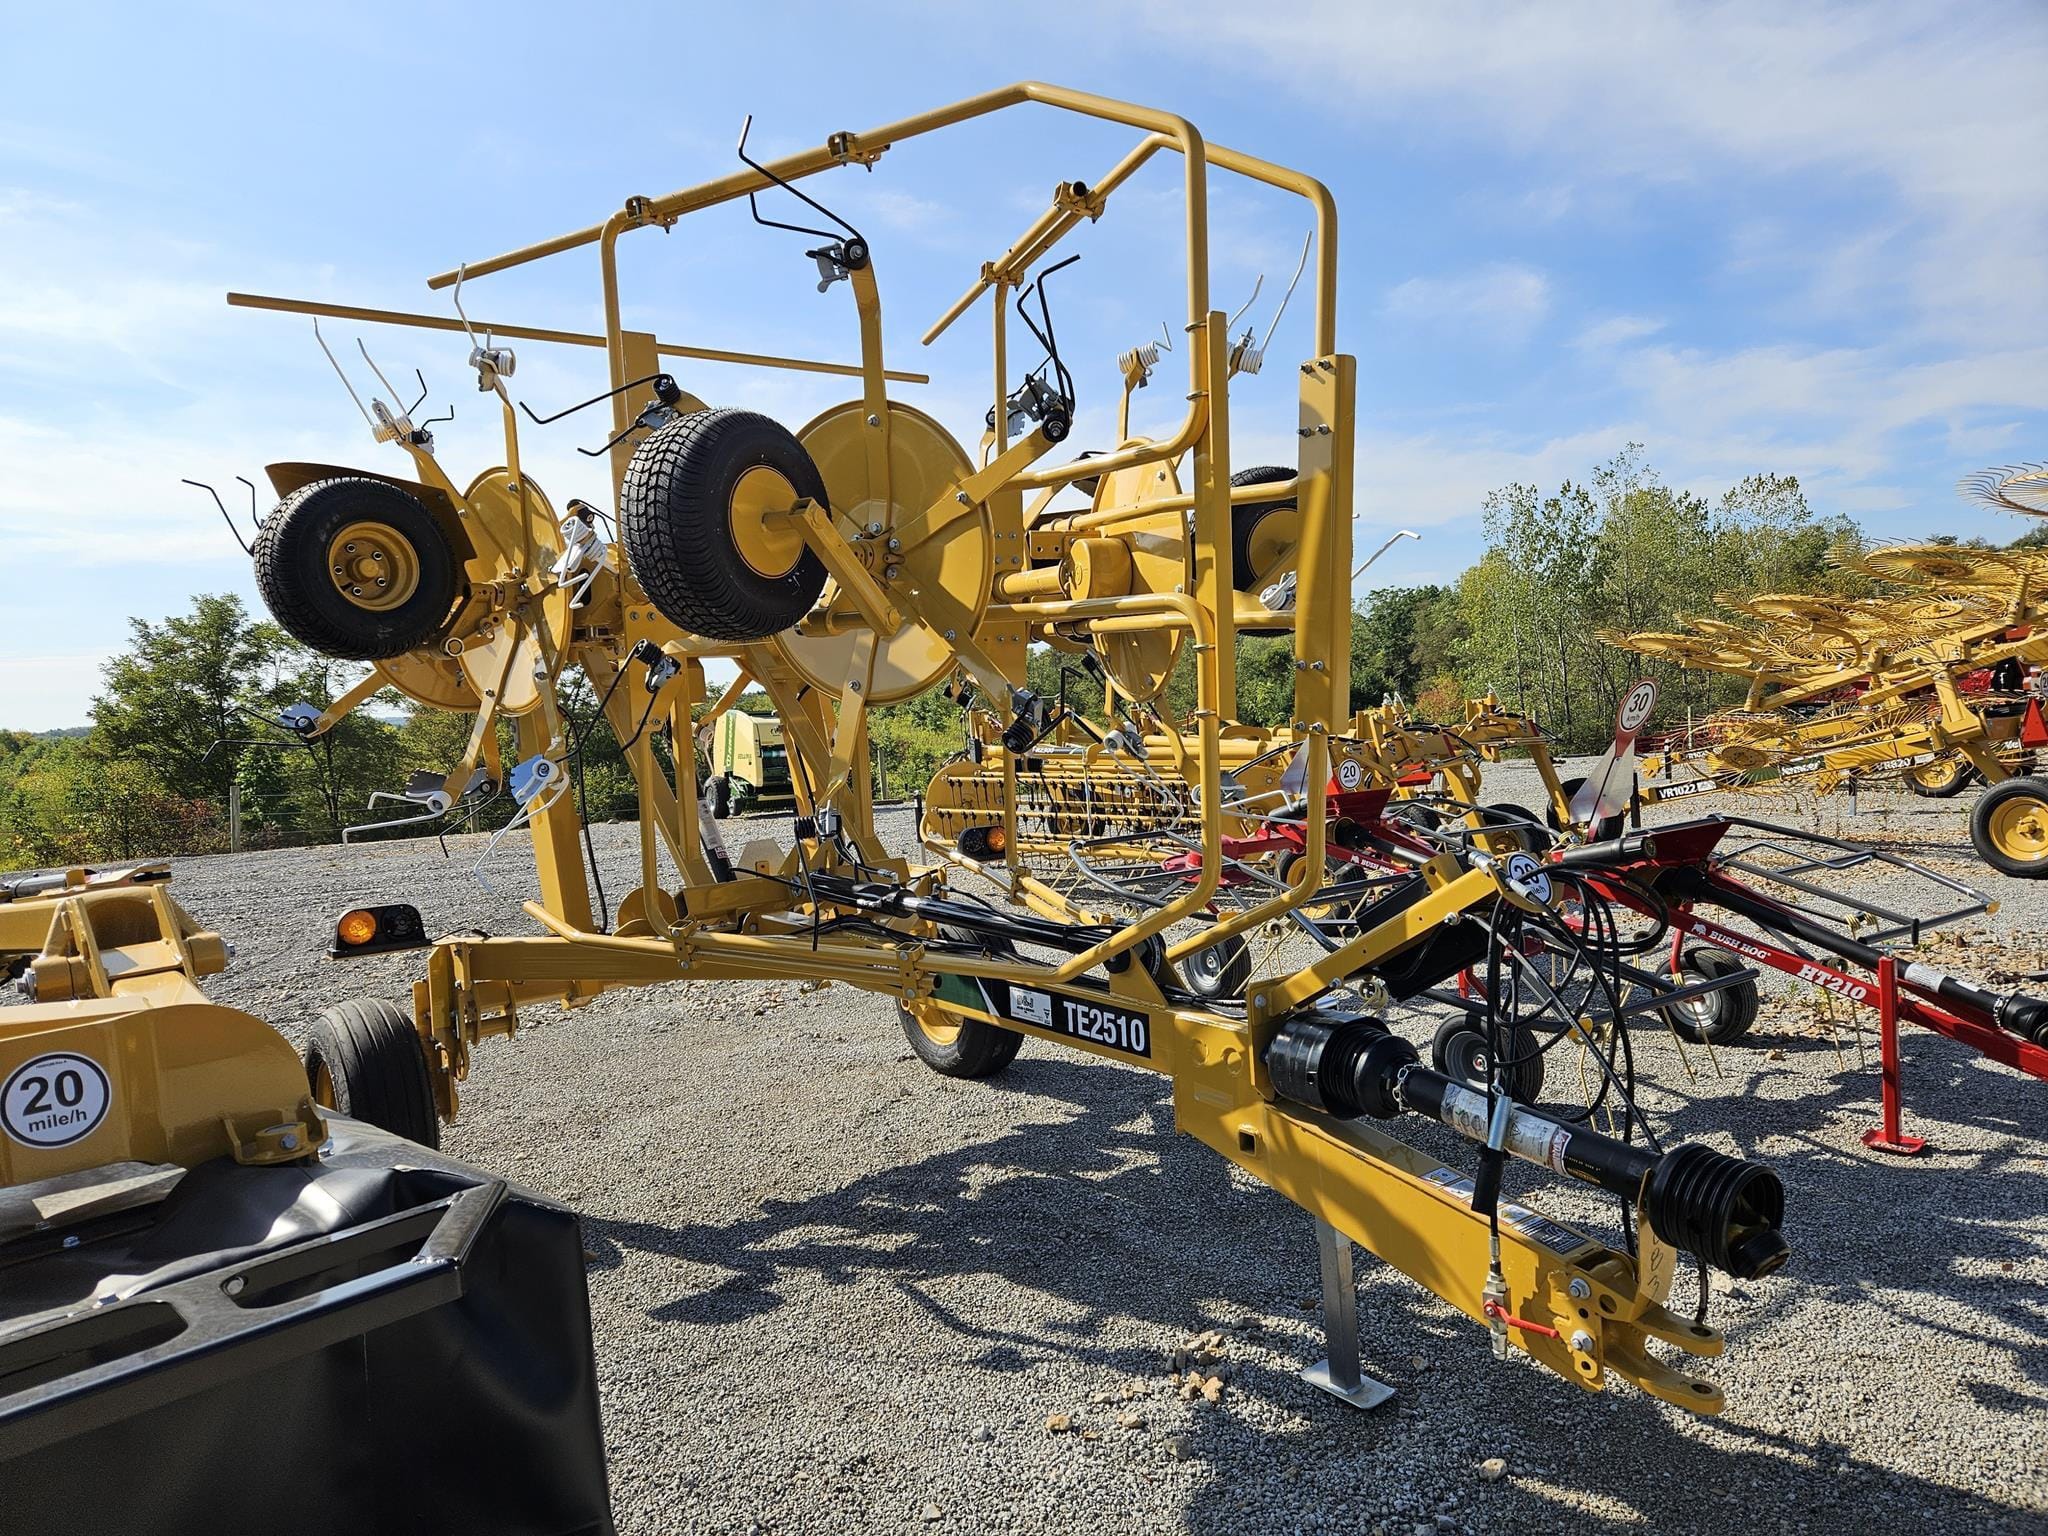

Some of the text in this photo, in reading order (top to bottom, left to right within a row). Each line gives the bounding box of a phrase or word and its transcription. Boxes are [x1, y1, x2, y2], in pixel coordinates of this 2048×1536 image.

[1629, 692, 1649, 712] 30
[1343, 765, 1356, 778] 20
[1659, 783, 1697, 799] VR1022
[1361, 859, 1379, 869] BUSH
[1708, 930, 1742, 949] BUSH
[1797, 964, 1868, 1000] HT210
[1063, 1001, 1145, 1052] TE2510
[20, 1070, 83, 1116] 20
[28, 1109, 87, 1132] mile/h
